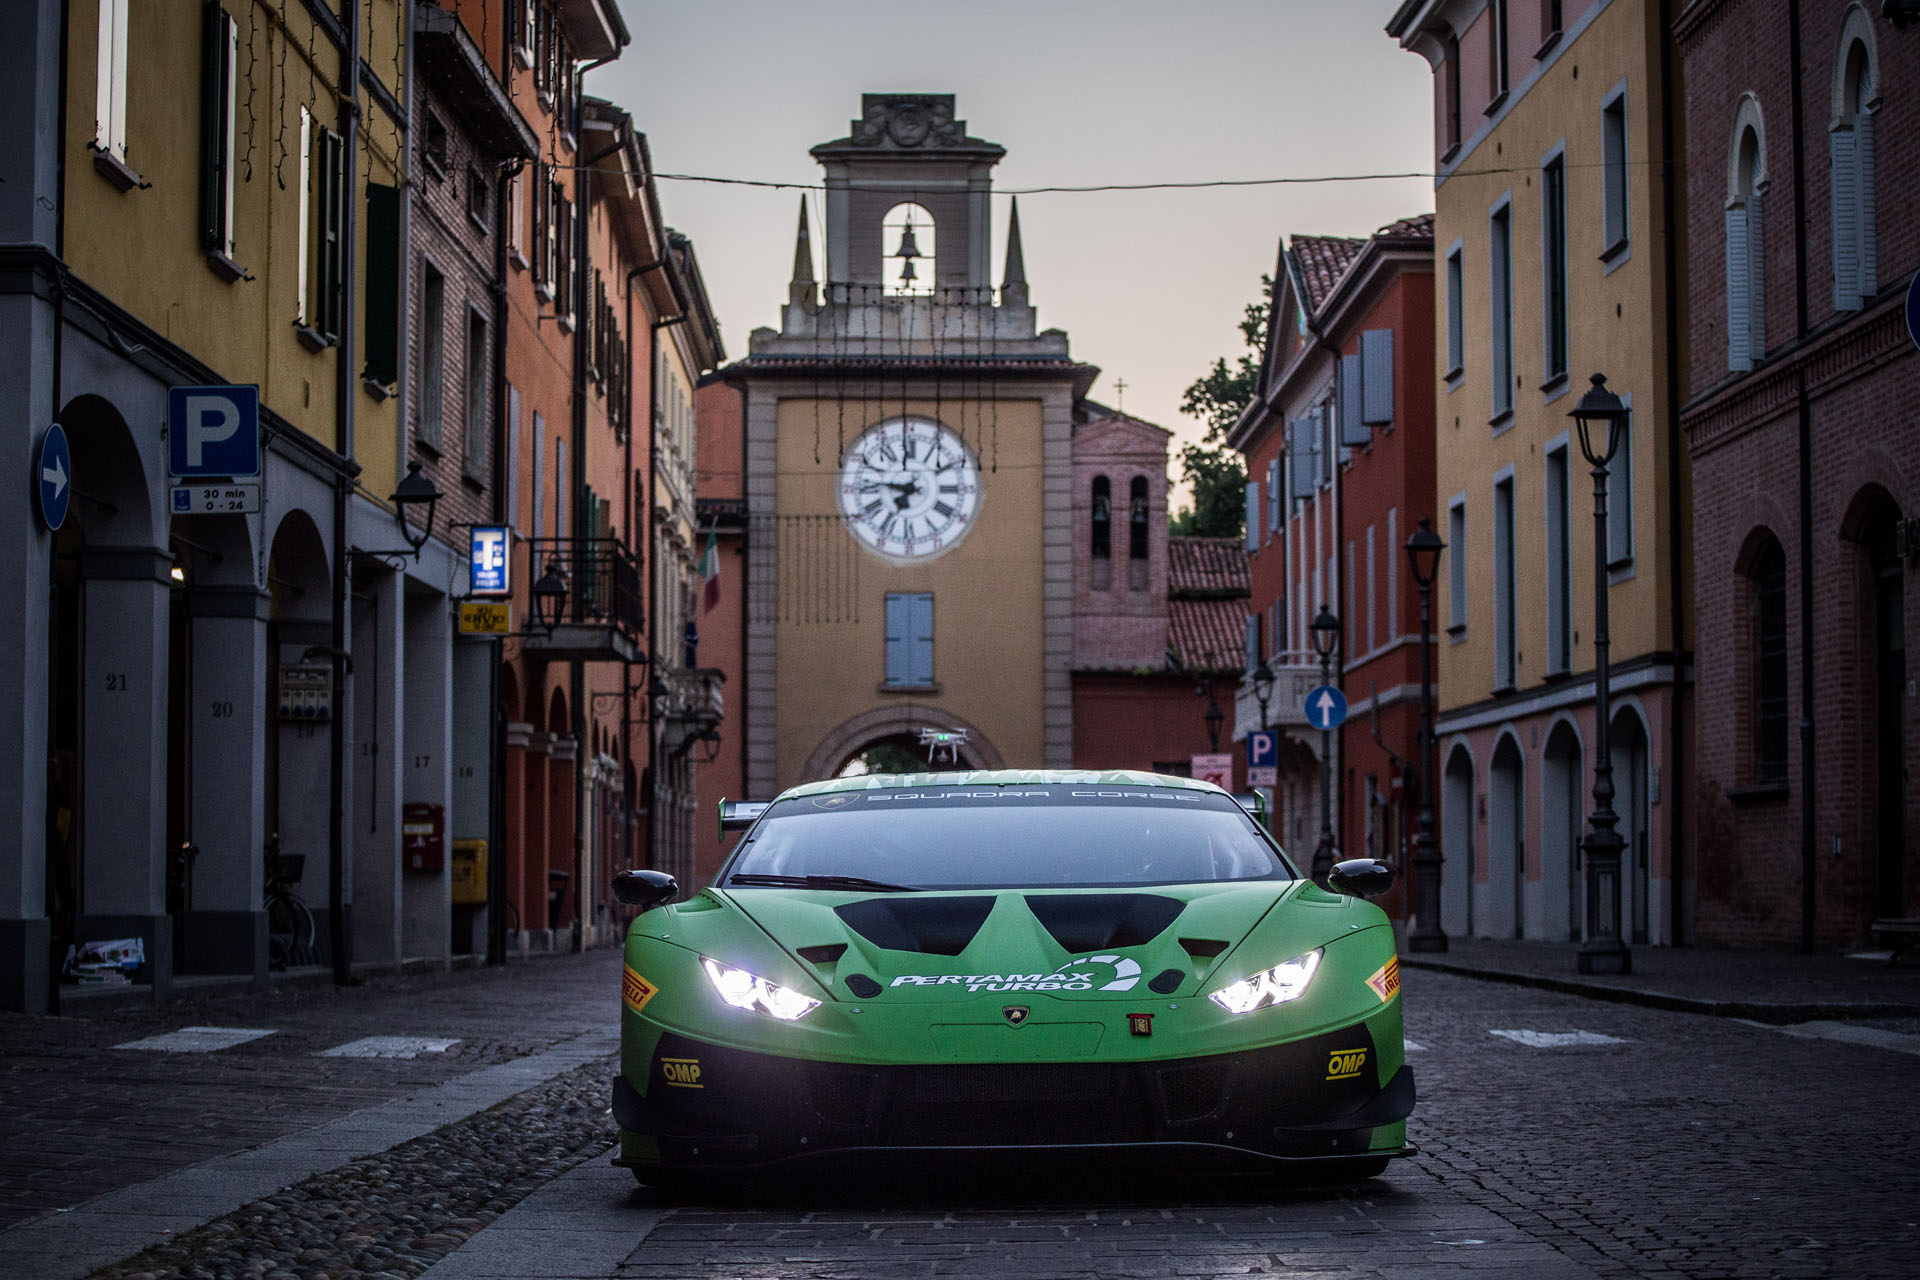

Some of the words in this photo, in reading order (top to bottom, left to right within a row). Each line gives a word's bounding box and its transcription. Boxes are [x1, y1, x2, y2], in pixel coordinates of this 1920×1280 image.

[186, 395, 240, 467] P
[203, 489, 219, 499] 30
[225, 489, 245, 499] min
[206, 501, 213, 510] 0
[228, 501, 243, 510] 24
[105, 673, 128, 691] 21
[212, 702, 233, 718] 20
[1253, 735, 1272, 764] P
[414, 756, 430, 769] 17
[867, 790, 1050, 802] SQUADRA
[1071, 790, 1201, 802] CORSE
[889, 972, 1096, 987] PERTAMAX
[963, 982, 1093, 993] TURBO
[1328, 1053, 1366, 1075] OMP
[663, 1062, 702, 1083] OMP
